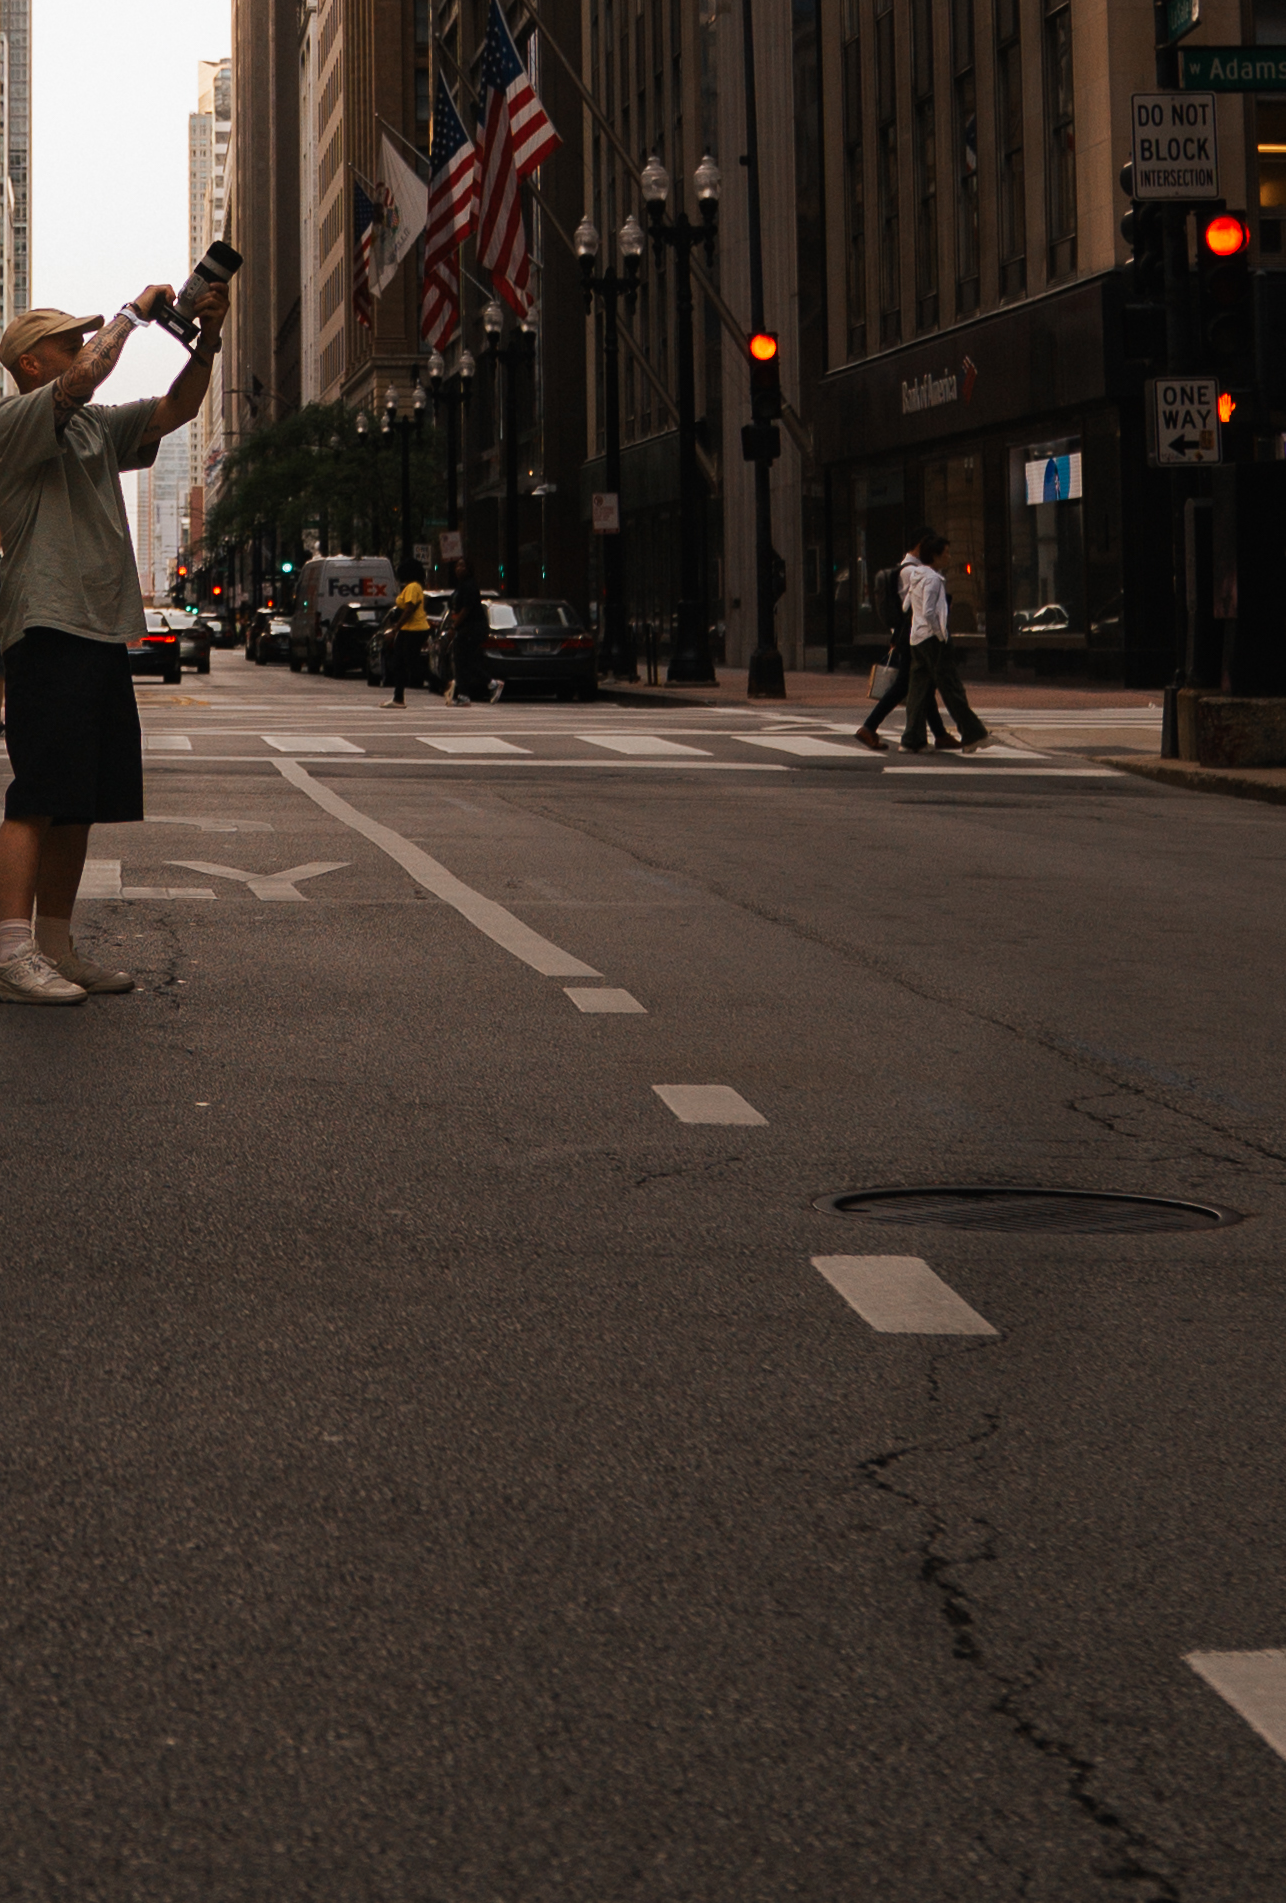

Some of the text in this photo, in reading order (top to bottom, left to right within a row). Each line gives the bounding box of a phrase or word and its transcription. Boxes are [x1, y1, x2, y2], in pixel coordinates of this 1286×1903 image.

[1209, 57, 1286, 80] Adams
[1138, 104, 1209, 127] DO NOT
[1140, 138, 1210, 161] BLOCK
[1141, 169, 1213, 187] INTERSECTION
[902, 378, 920, 415] Bank
[928, 367, 957, 407] America
[1163, 386, 1210, 406] ONE
[1163, 409, 1211, 429] WAY
[328, 577, 387, 597] FedEx
